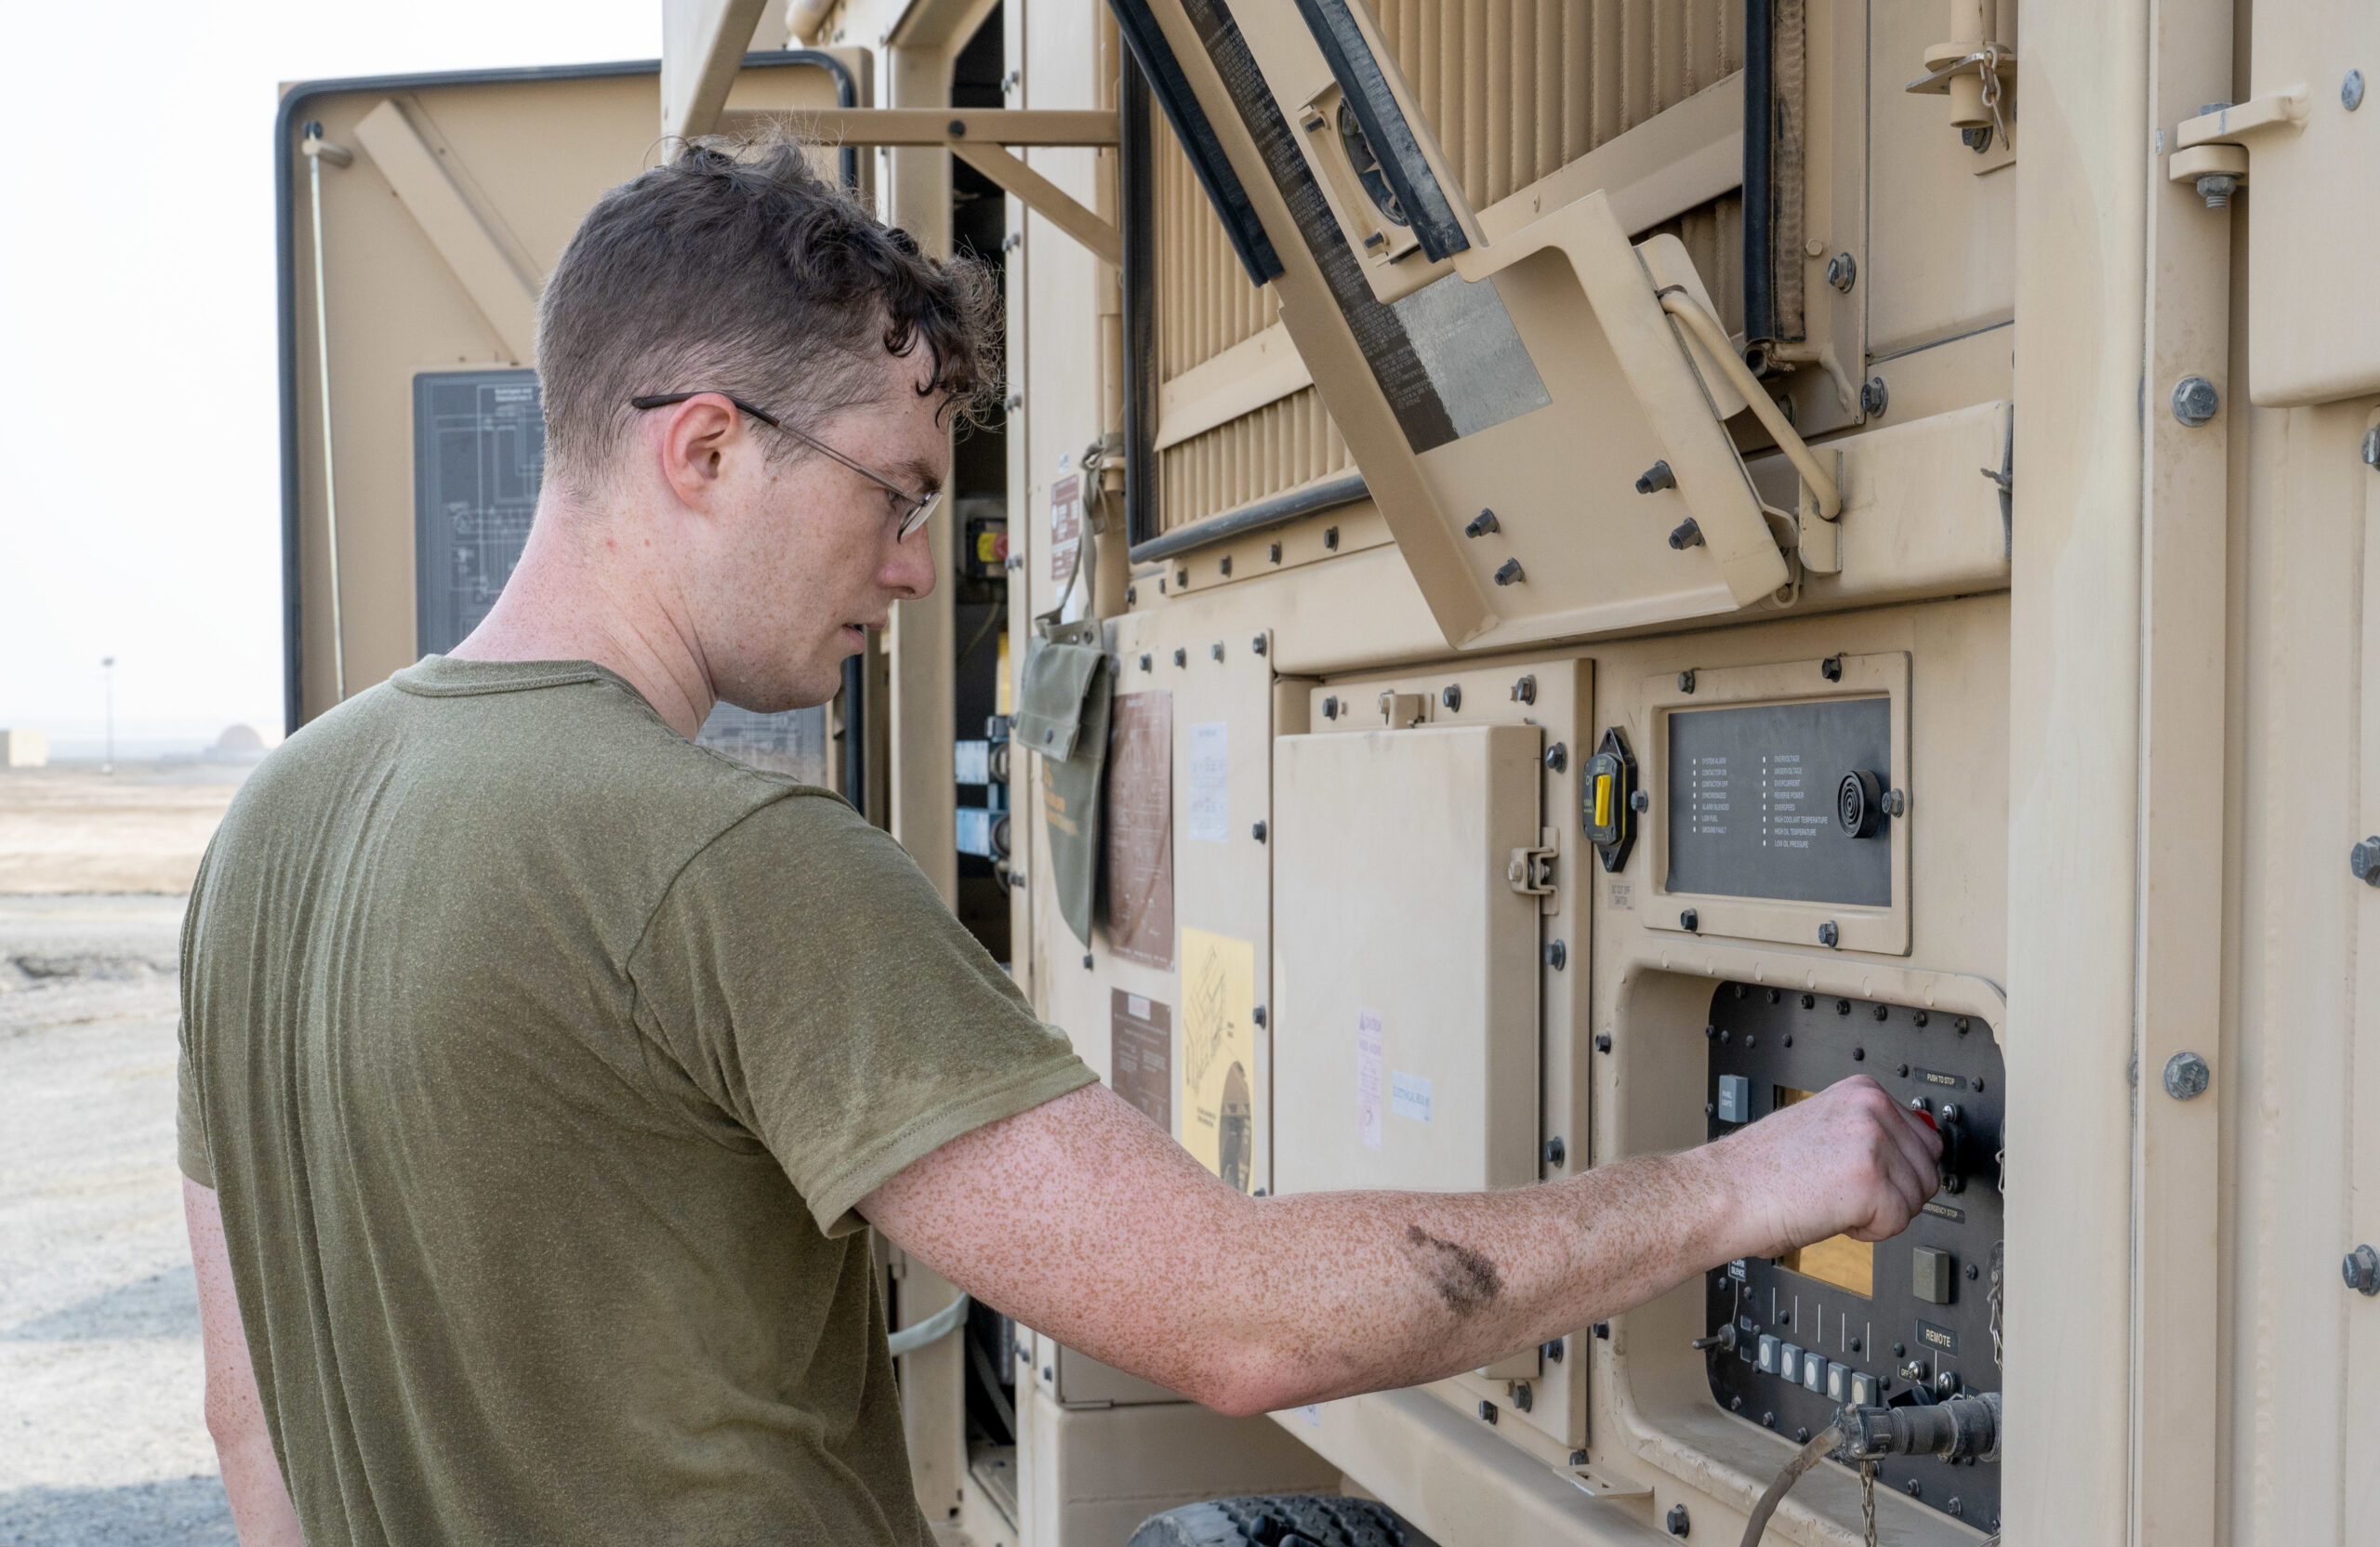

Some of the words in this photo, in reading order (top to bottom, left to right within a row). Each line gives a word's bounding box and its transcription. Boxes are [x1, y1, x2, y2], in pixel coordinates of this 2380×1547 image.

[1801, 816, 1829, 825] TEMPERATURE
[1926, 1073, 1937, 1082] PUSH
[1944, 1076, 1955, 1085] STOP
[1947, 1209, 1958, 1218] STOP
[1925, 1329, 1950, 1347] REMOTE
